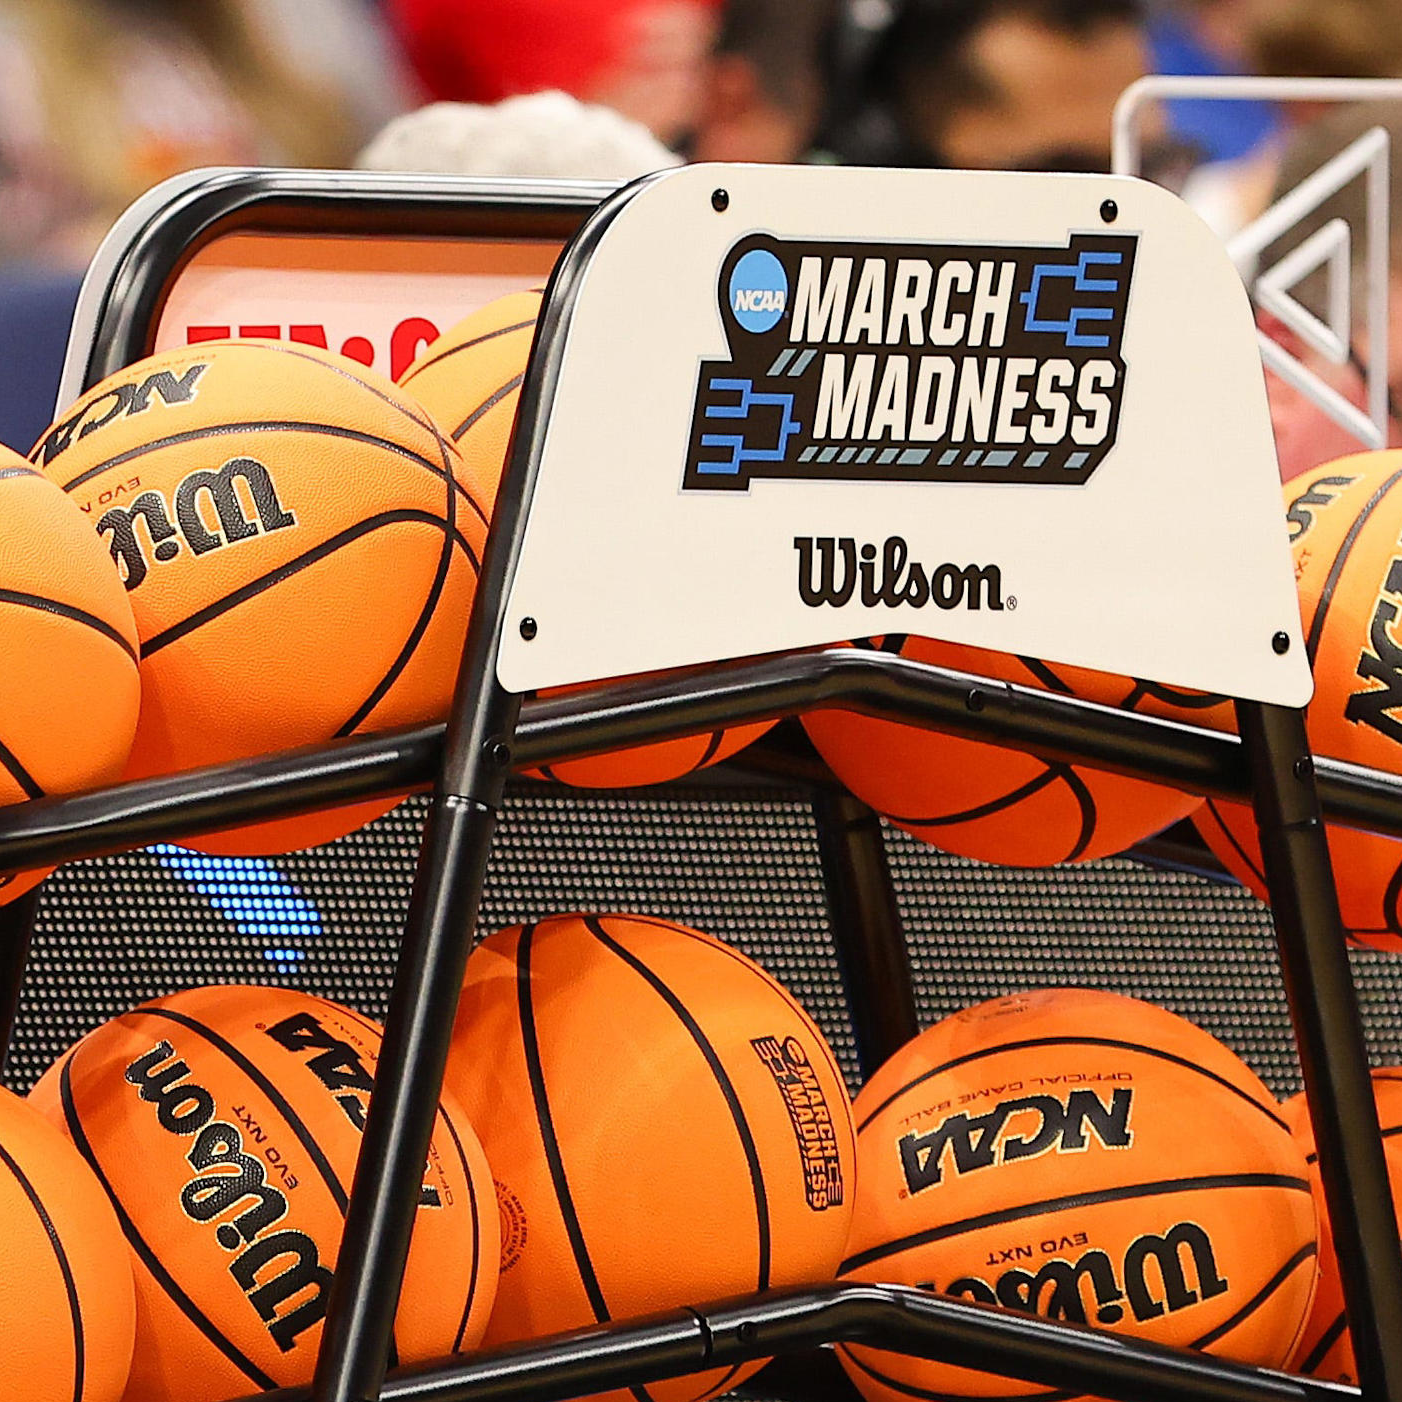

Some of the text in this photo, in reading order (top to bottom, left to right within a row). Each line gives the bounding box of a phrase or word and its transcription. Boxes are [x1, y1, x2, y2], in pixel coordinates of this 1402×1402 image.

[733, 286, 788, 314] NCAA
[788, 256, 1017, 347] MARCH
[811, 355, 1118, 446] MADNESS
[94, 456, 299, 592] Wil
[98, 476, 141, 505] EVO
[793, 535, 1005, 612] Wilson
[795, 1065, 837, 1159] MARCH
[957, 1081, 1024, 1105] GAME
[1030, 1071, 1133, 1086] OFFICIAL
[230, 1103, 299, 1191] EVO NXT
[786, 1082, 829, 1210] MADNESS
[897, 1086, 1135, 1197] NCAA
[124, 1039, 337, 1354] Wilson
[915, 1220, 1230, 1327] Wils
[985, 1231, 1090, 1267] EVO NXT
